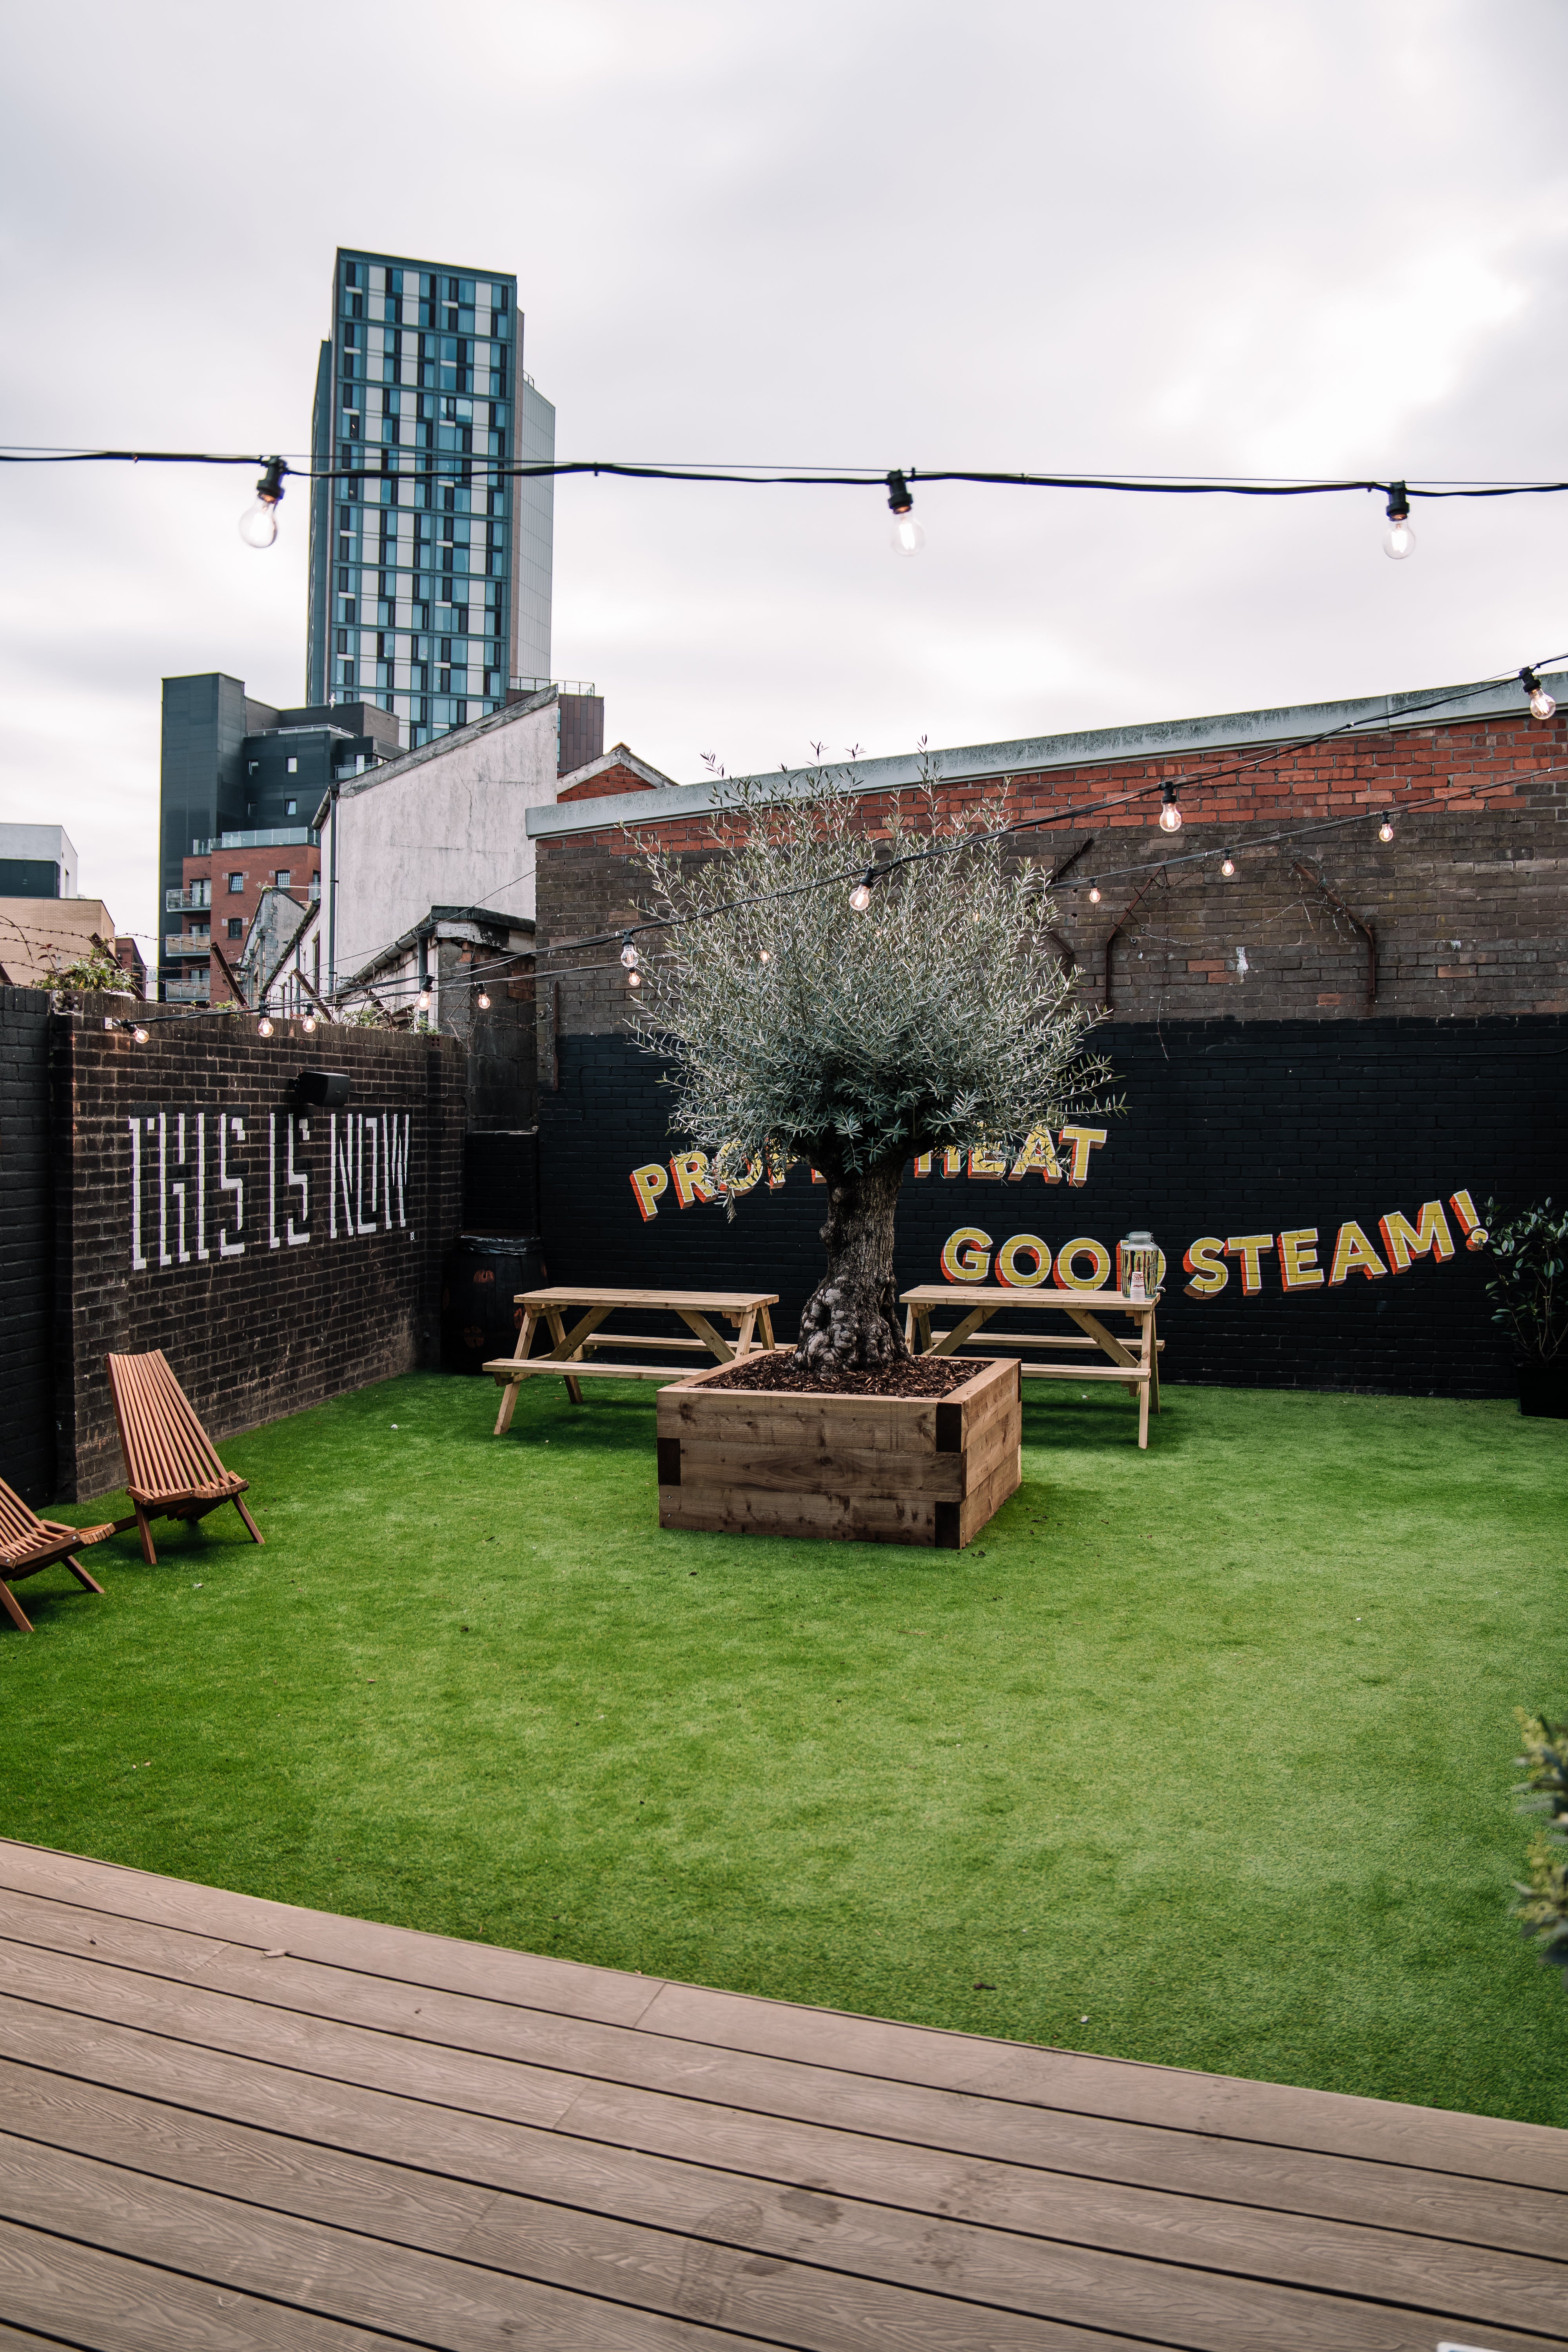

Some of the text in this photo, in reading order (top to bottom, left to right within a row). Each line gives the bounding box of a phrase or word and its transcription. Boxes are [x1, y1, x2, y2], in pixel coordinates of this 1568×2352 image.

[129, 1112, 409, 1270] THIS IS NOW
[630, 1136, 828, 1222] PRO
[1183, 1189, 1489, 1299] STEAM!
